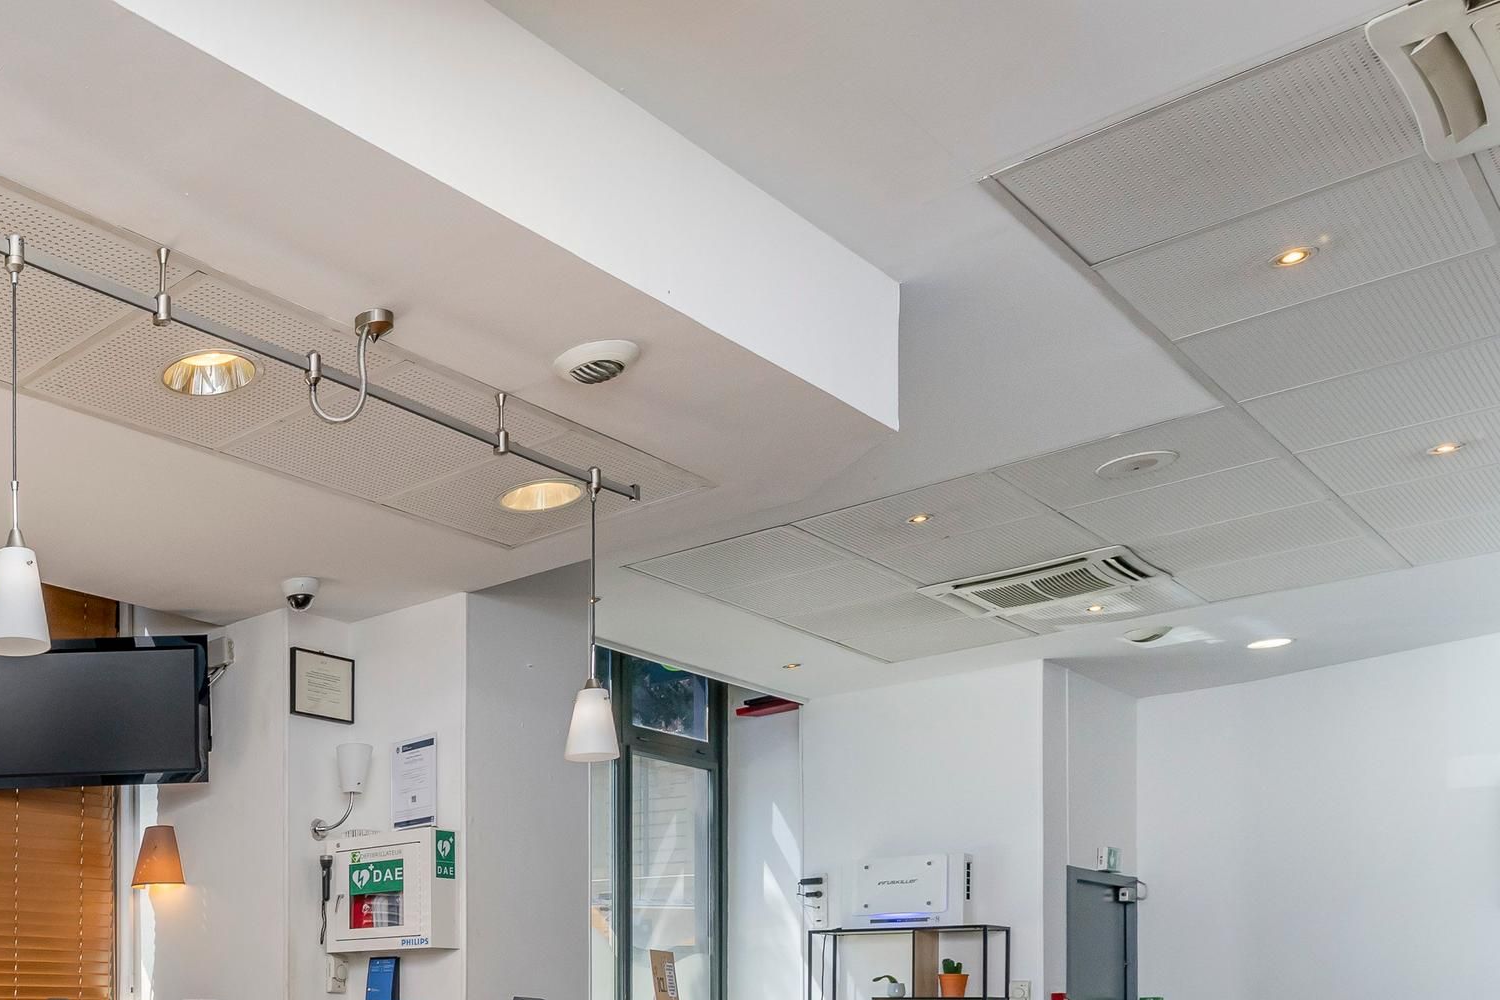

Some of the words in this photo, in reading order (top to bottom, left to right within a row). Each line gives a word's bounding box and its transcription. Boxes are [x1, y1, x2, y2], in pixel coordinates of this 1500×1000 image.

[373, 868, 403, 883] DAE
[437, 865, 454, 876] DAE
[401, 937, 429, 946] PHILIPS
